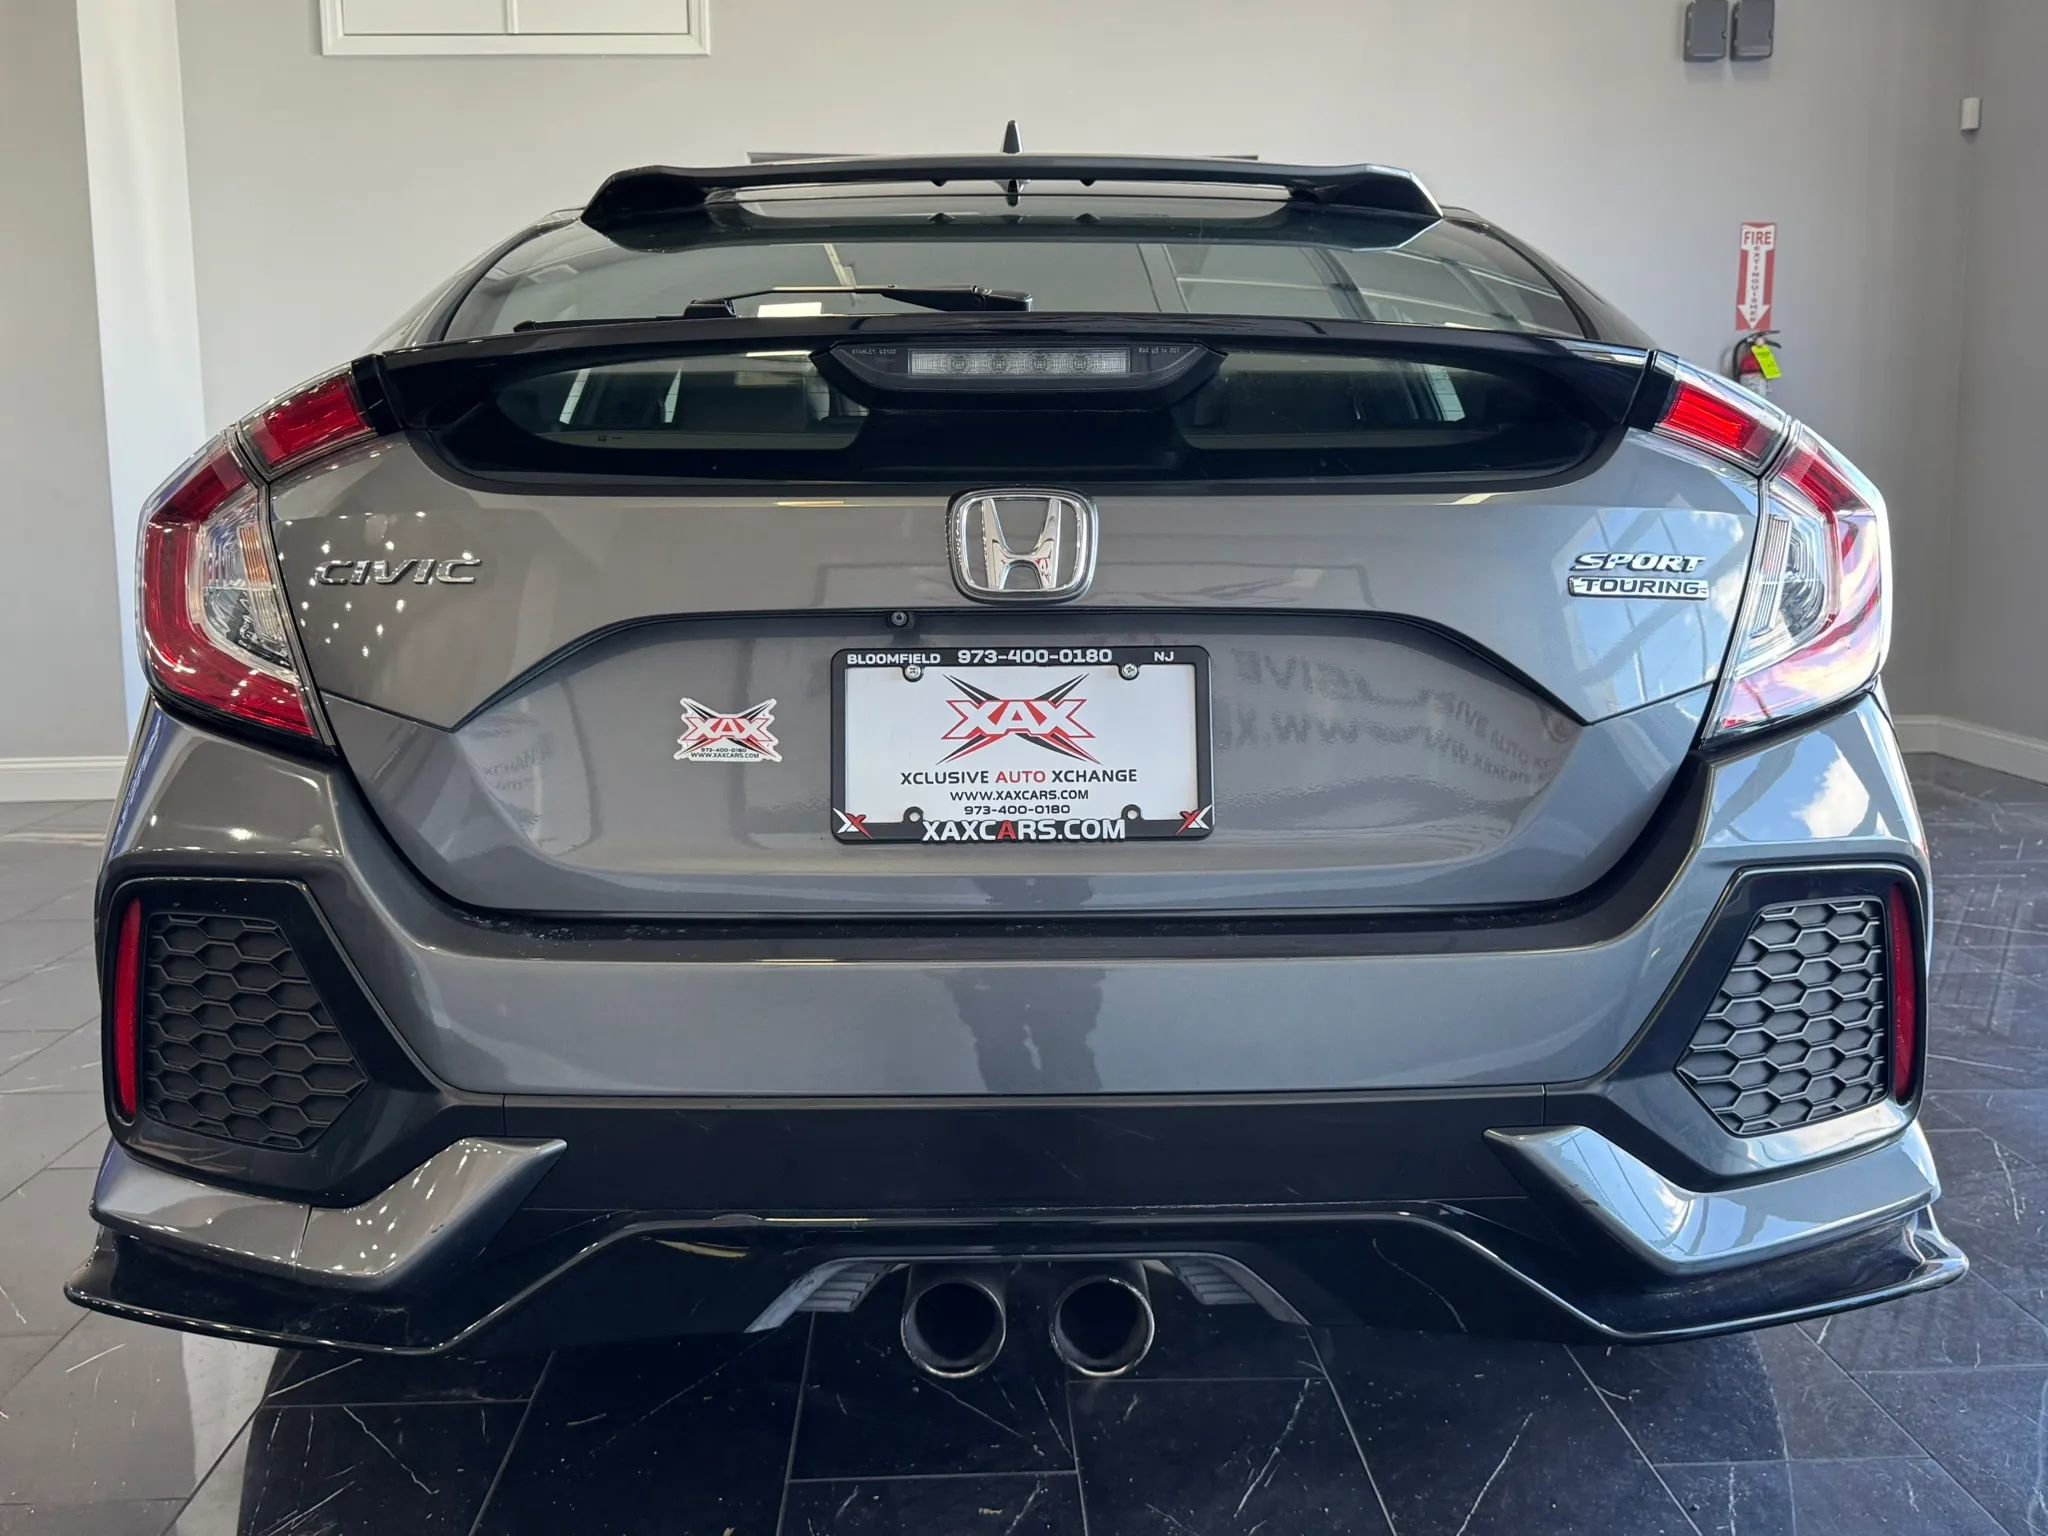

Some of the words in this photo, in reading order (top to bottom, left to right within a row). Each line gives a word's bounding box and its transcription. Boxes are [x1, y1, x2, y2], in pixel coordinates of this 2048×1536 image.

[1743, 230, 1772, 246] FIRE
[1570, 551, 1706, 573] SPORT
[314, 558, 482, 585] CIVIC
[1580, 577, 1700, 595] TOURING
[846, 652, 941, 665] BLOOMFIELD
[957, 648, 1113, 665] 973-400-0180
[1153, 651, 1175, 663] NJ
[941, 698, 1096, 740] XAX
[681, 716, 776, 742] XAX
[900, 770, 989, 785] XCLUSIVE
[995, 769, 1046, 784] AUTO
[1052, 768, 1137, 783] XCHANGE
[950, 789, 1089, 801] WWW.XAXCARS.COM
[963, 804, 1071, 816] 973-400-0180
[922, 819, 1126, 842] XAXCARS.COM
